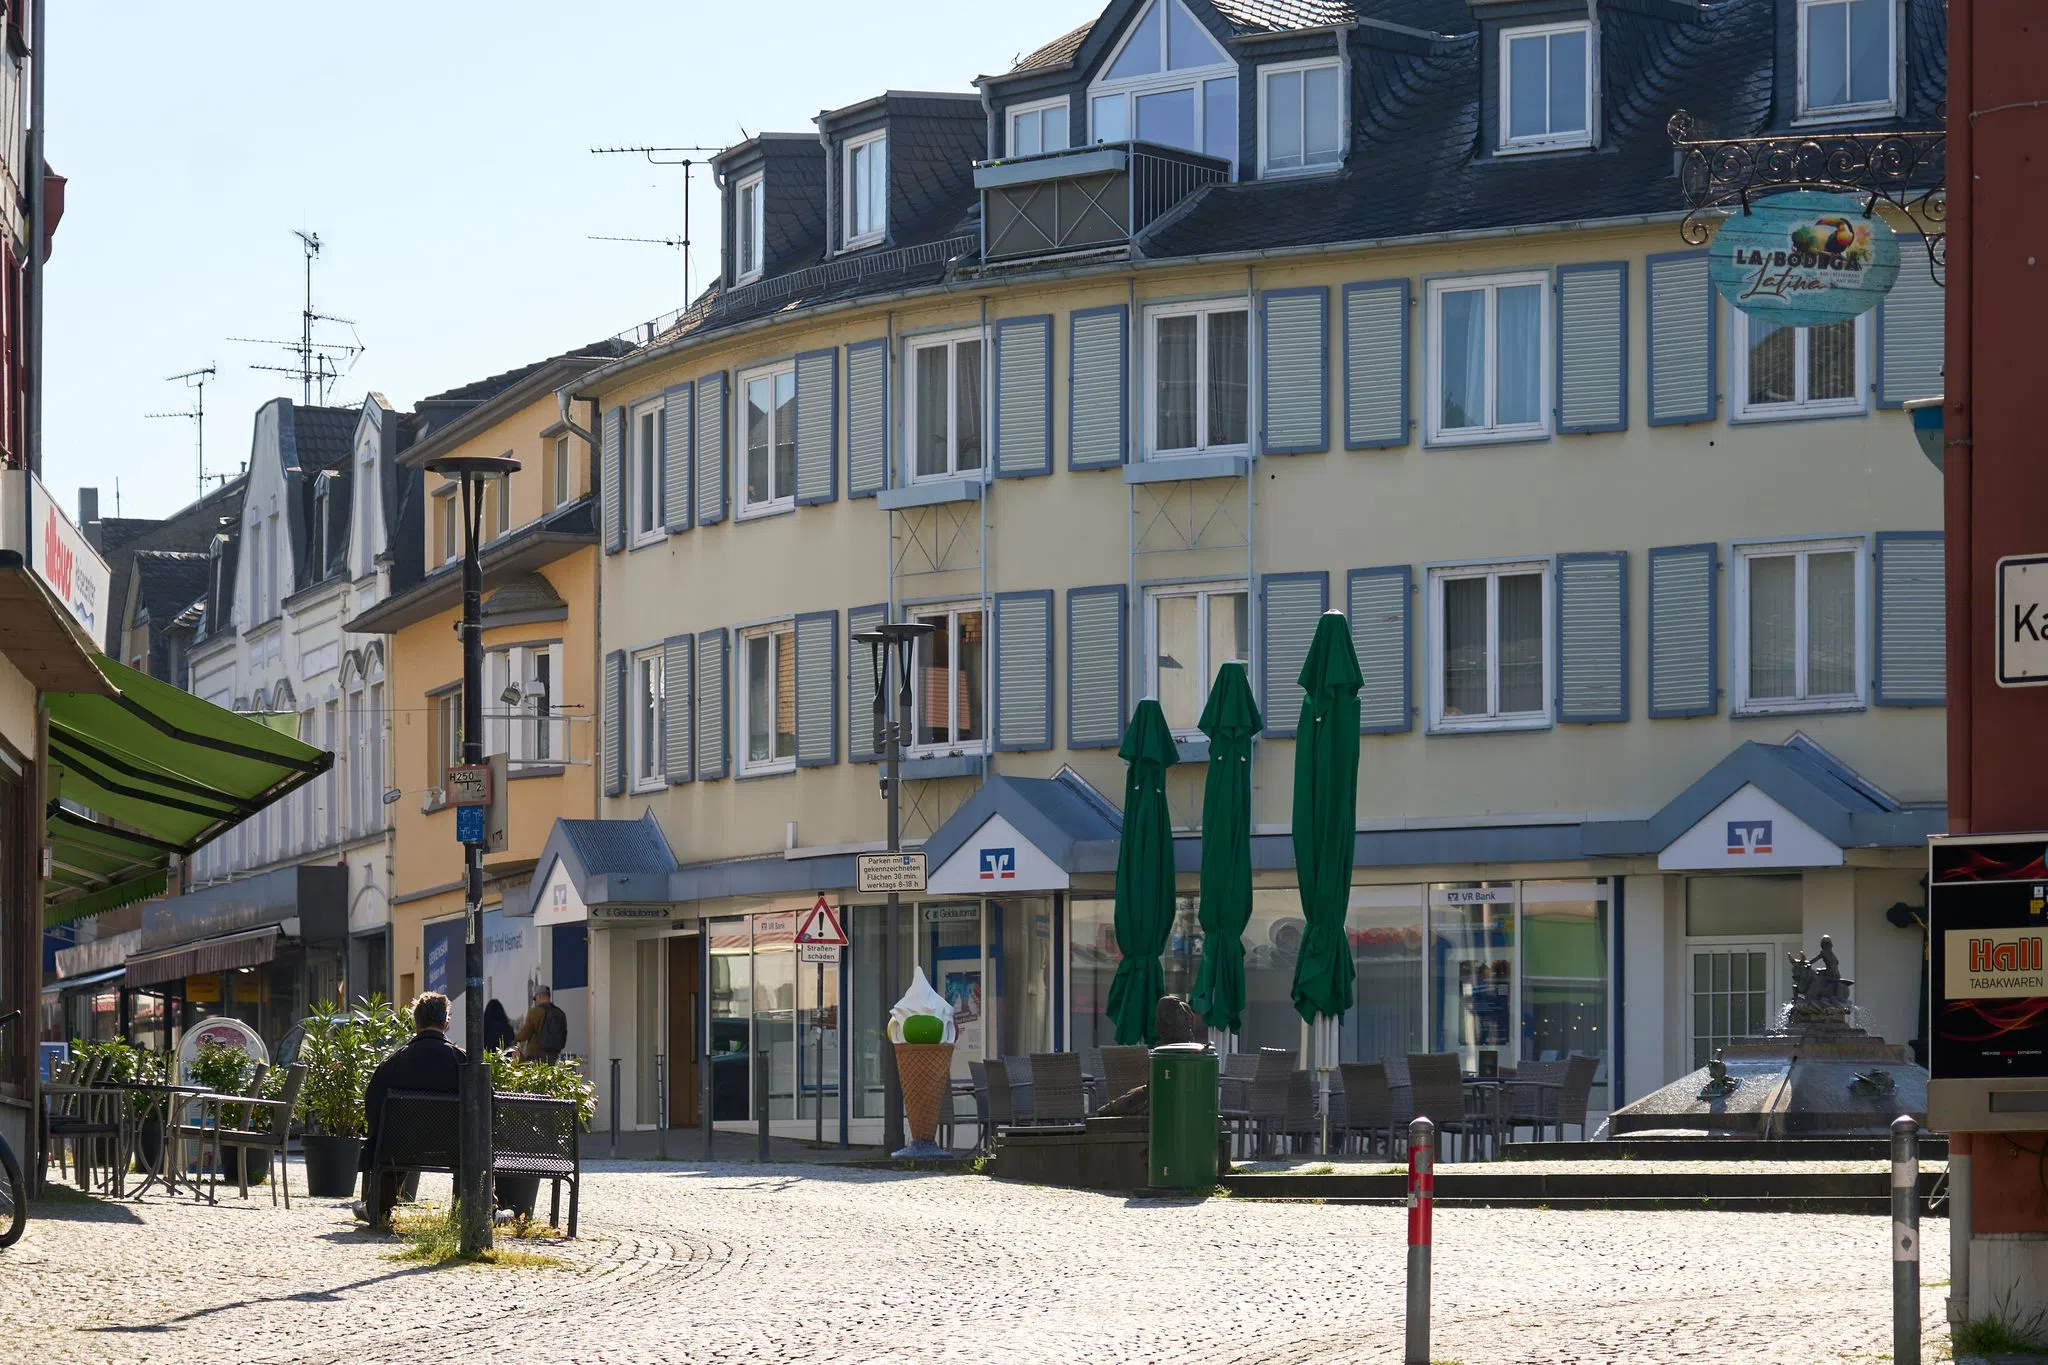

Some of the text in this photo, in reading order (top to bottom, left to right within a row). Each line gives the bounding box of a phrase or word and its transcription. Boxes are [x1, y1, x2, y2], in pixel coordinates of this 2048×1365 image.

[1736, 249, 1862, 271] LA BODEGA
[1741, 252, 1824, 301] Latina
[863, 865, 920, 873] gekennzeichneten
[1462, 891, 1496, 901] VR Bank
[613, 908, 659, 917] Geldautomat
[939, 908, 977, 918] Geldautomat
[1969, 937, 2043, 972] Hall
[1969, 977, 2043, 989] TABAKWAREN
